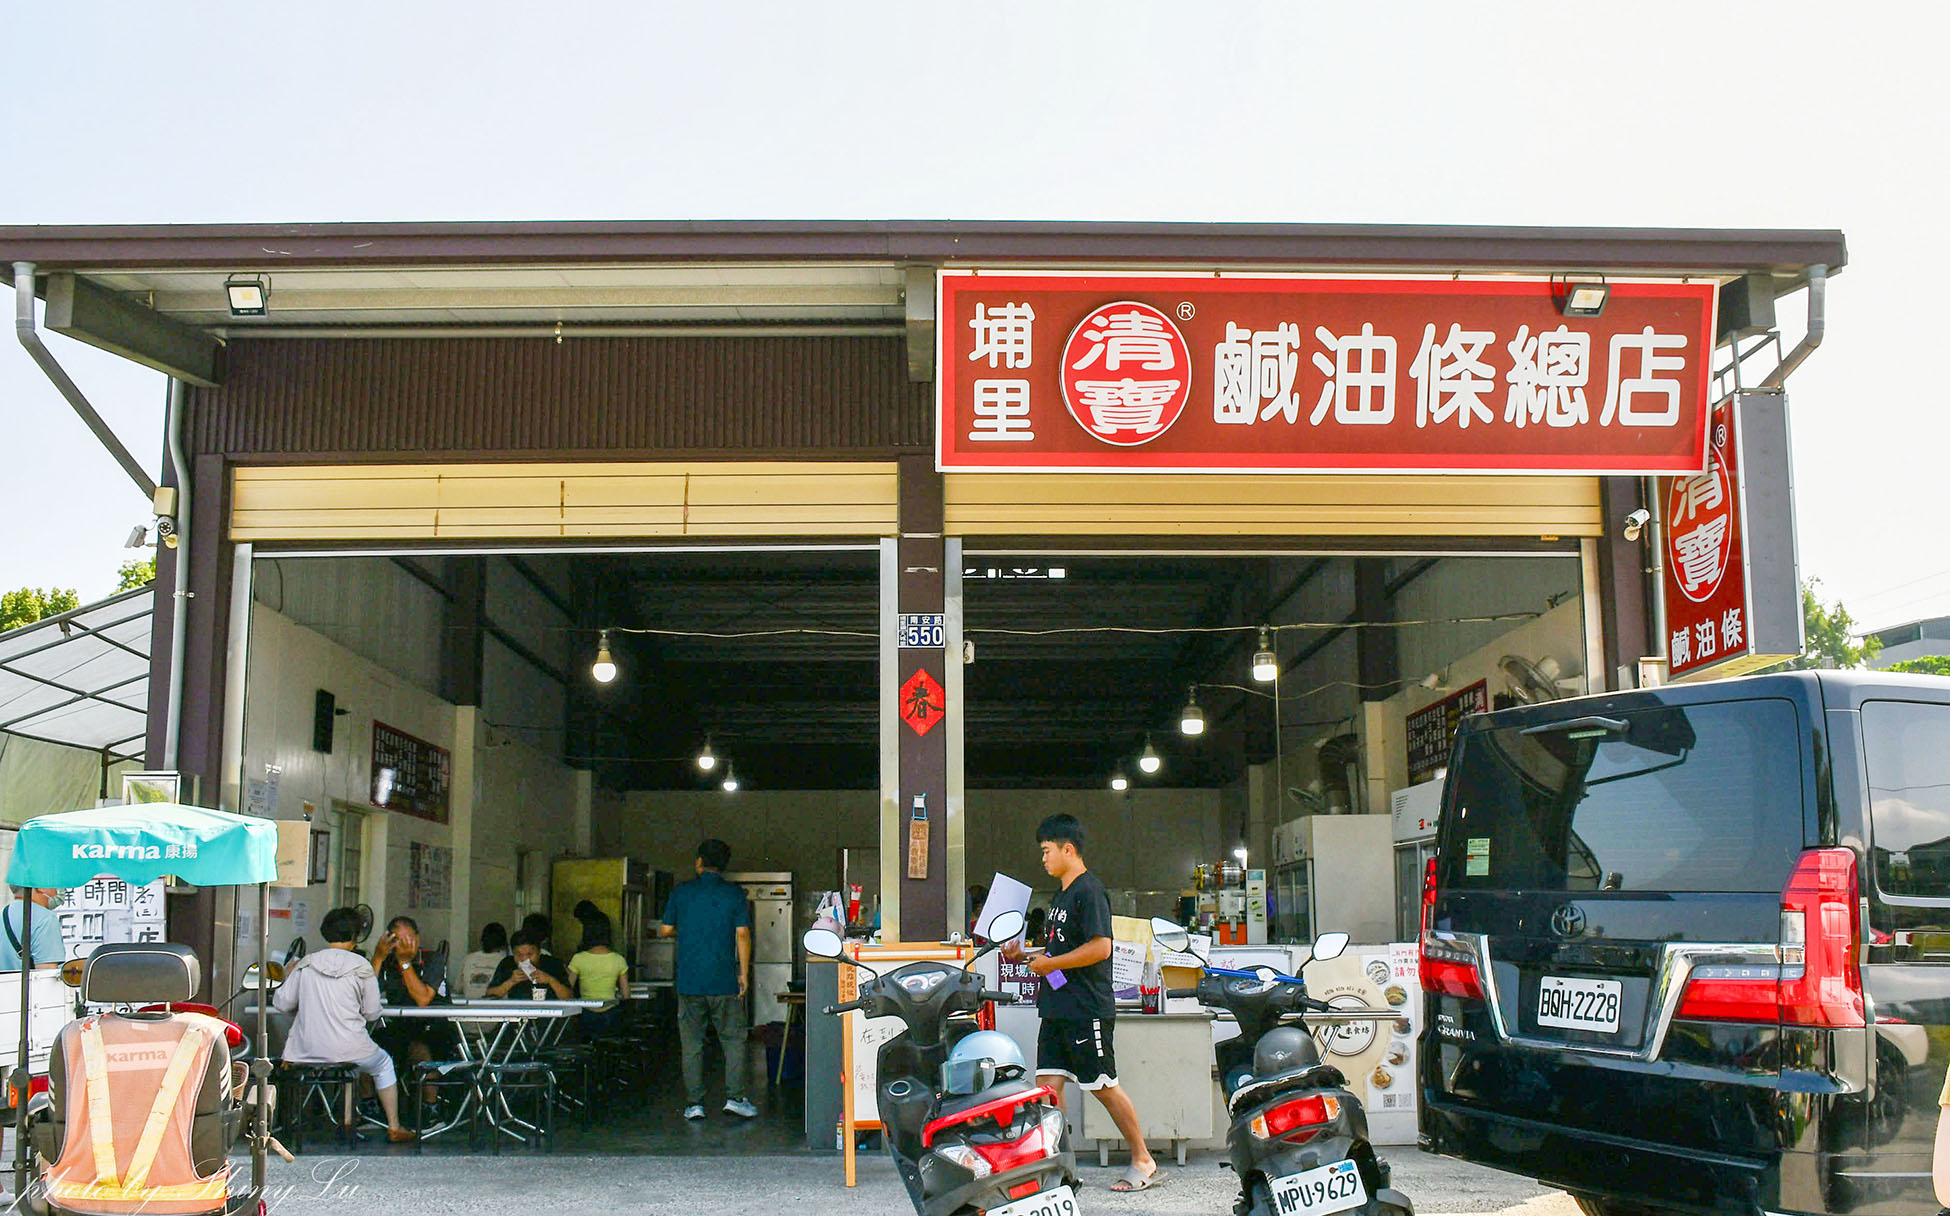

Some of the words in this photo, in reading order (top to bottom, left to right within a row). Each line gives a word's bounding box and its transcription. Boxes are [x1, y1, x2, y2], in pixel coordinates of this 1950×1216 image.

[968, 302, 1037, 443] 埔里
[1076, 309, 1182, 435] 清寶
[1213, 321, 1689, 430] 鹹油條總店
[908, 626, 943, 646] 550
[1671, 607, 1743, 669] 鹹油條
[906, 681, 944, 719] 春
[165, 844, 198, 859] 康揚
